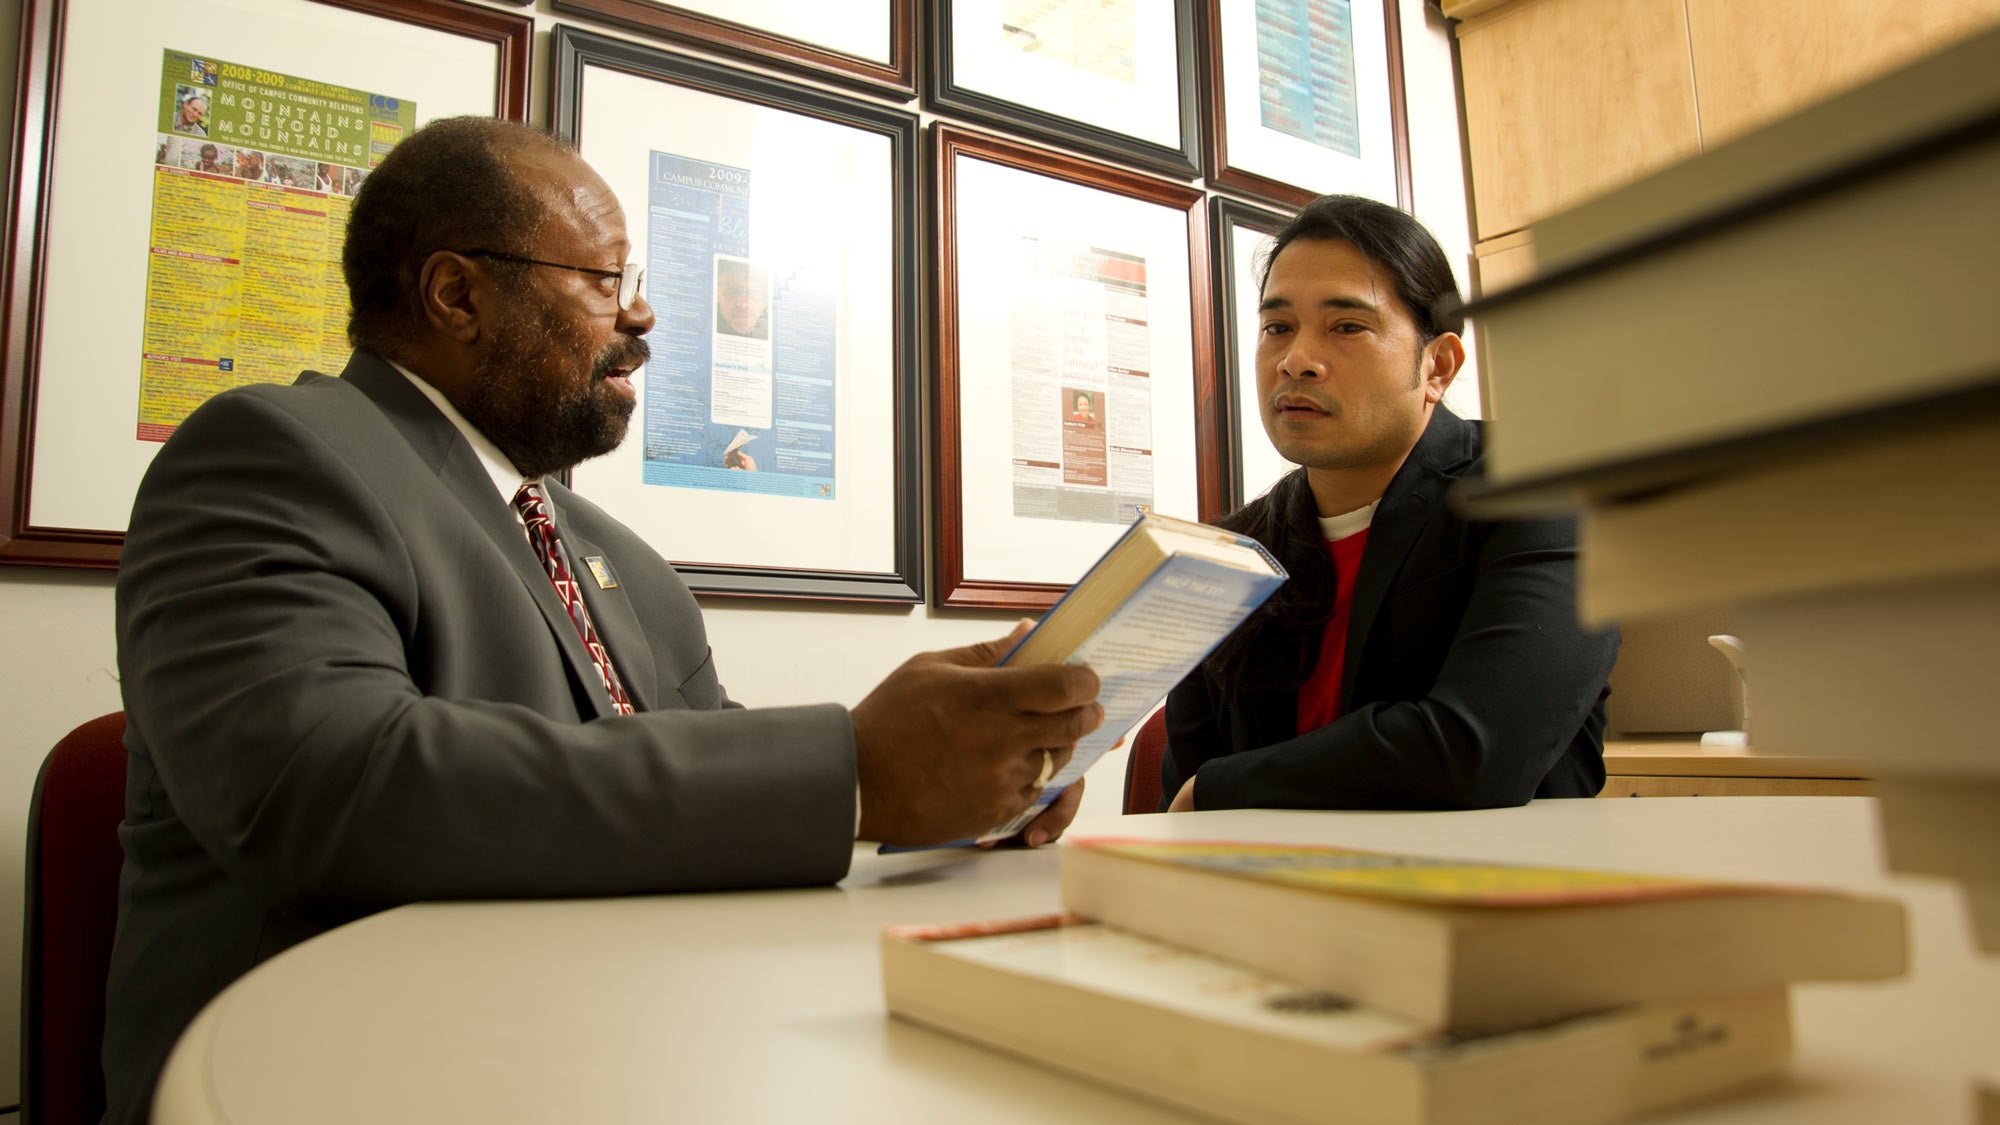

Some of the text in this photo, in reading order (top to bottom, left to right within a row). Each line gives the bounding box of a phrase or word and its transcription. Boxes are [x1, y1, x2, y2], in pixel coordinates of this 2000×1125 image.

[222, 64, 285, 87] 2008-2009
[220, 92, 364, 131] MOUNTAINS
[222, 80, 246, 93] OFFICE
[248, 85, 257, 94] OF
[259, 87, 286, 101] CAMPUS
[288, 94, 328, 108] COMMUNITY
[329, 100, 364, 115] RELATIONS
[218, 119, 362, 156] MOUNTAINS
[245, 111, 339, 139] BEYOND
[663, 172, 750, 195] CAMPUS COMMUNI
[709, 167, 748, 184] 2009-
